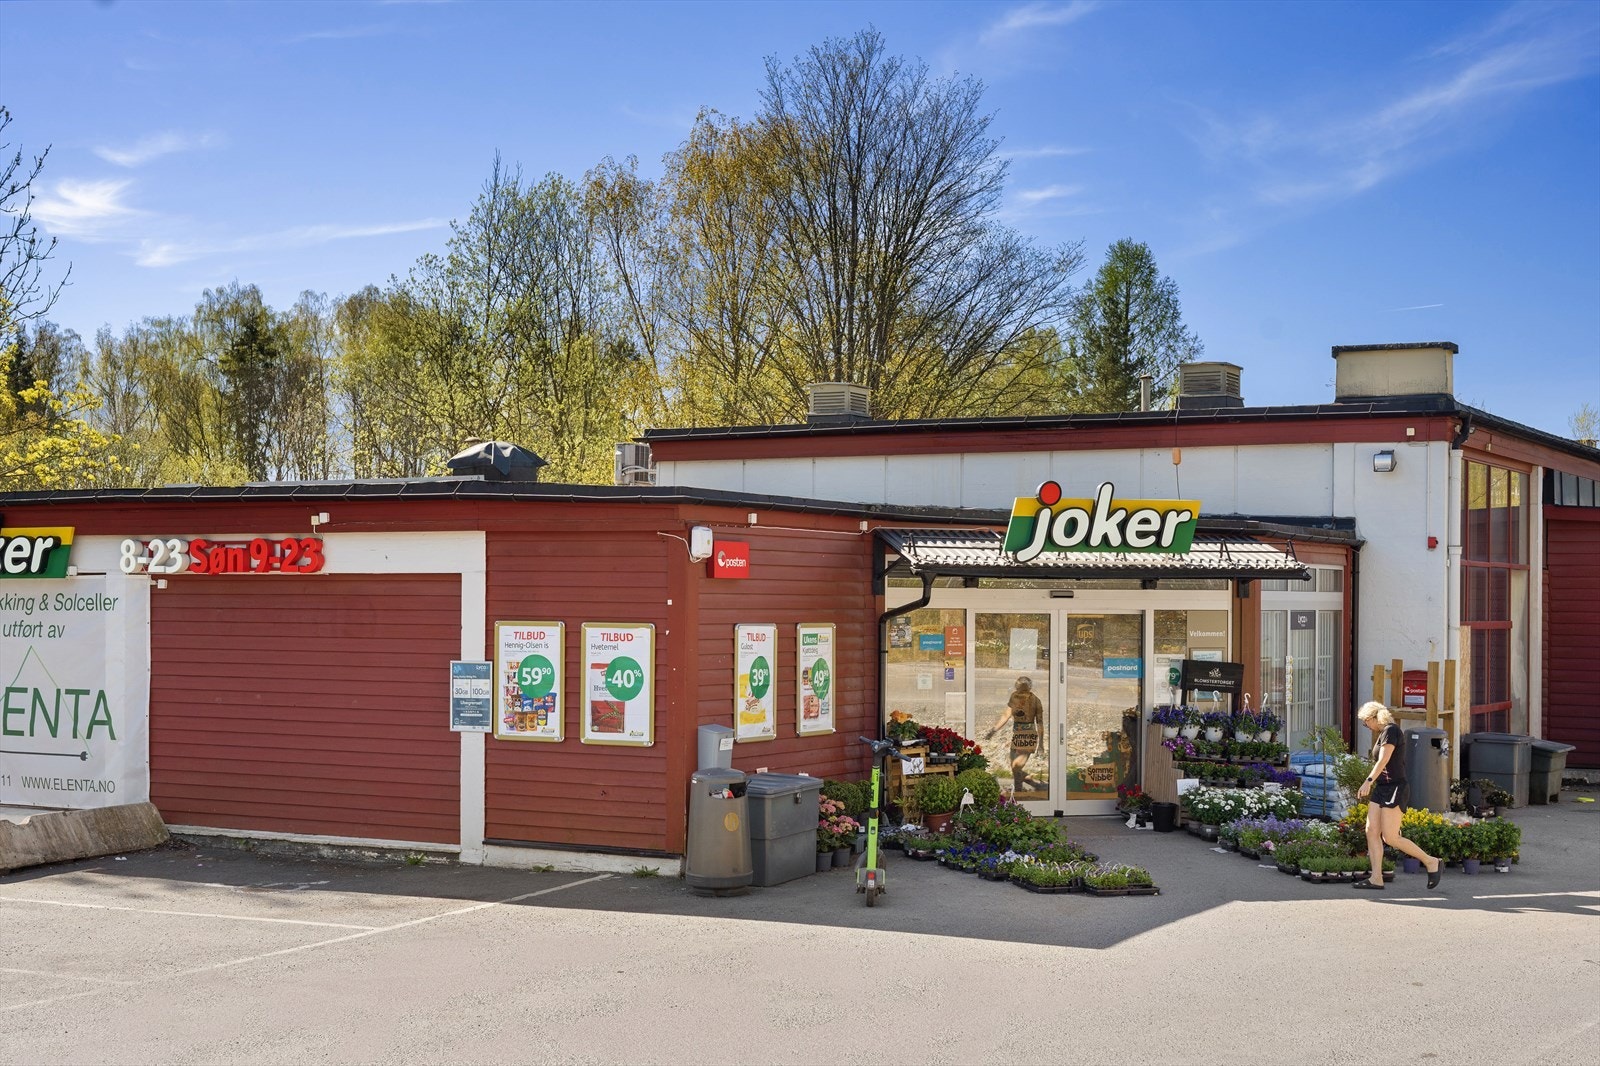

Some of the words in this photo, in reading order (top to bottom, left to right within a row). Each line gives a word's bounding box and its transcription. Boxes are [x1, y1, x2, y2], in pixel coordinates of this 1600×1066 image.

[1015, 481, 1193, 563] joker
[0, 536, 54, 574] er
[120, 539, 186, 573] 8-23
[189, 538, 247, 575] Søn
[250, 538, 323, 573] 9-23
[725, 557, 747, 569] posten
[39, 593, 49, 611] &
[54, 592, 119, 612] Solceller
[3, 620, 43, 638] utført
[47, 624, 65, 638] av
[513, 631, 546, 640] TILBUD
[600, 633, 634, 642] TILBUD
[746, 633, 767, 642] TILBUD
[504, 642, 543, 650] Hennig-Olsen
[590, 643, 619, 651] Hvetemel
[1107, 664, 1138, 672] postnord
[607, 669, 642, 688] -40%
[21, 776, 116, 793] WWW.ELENTA.NO
